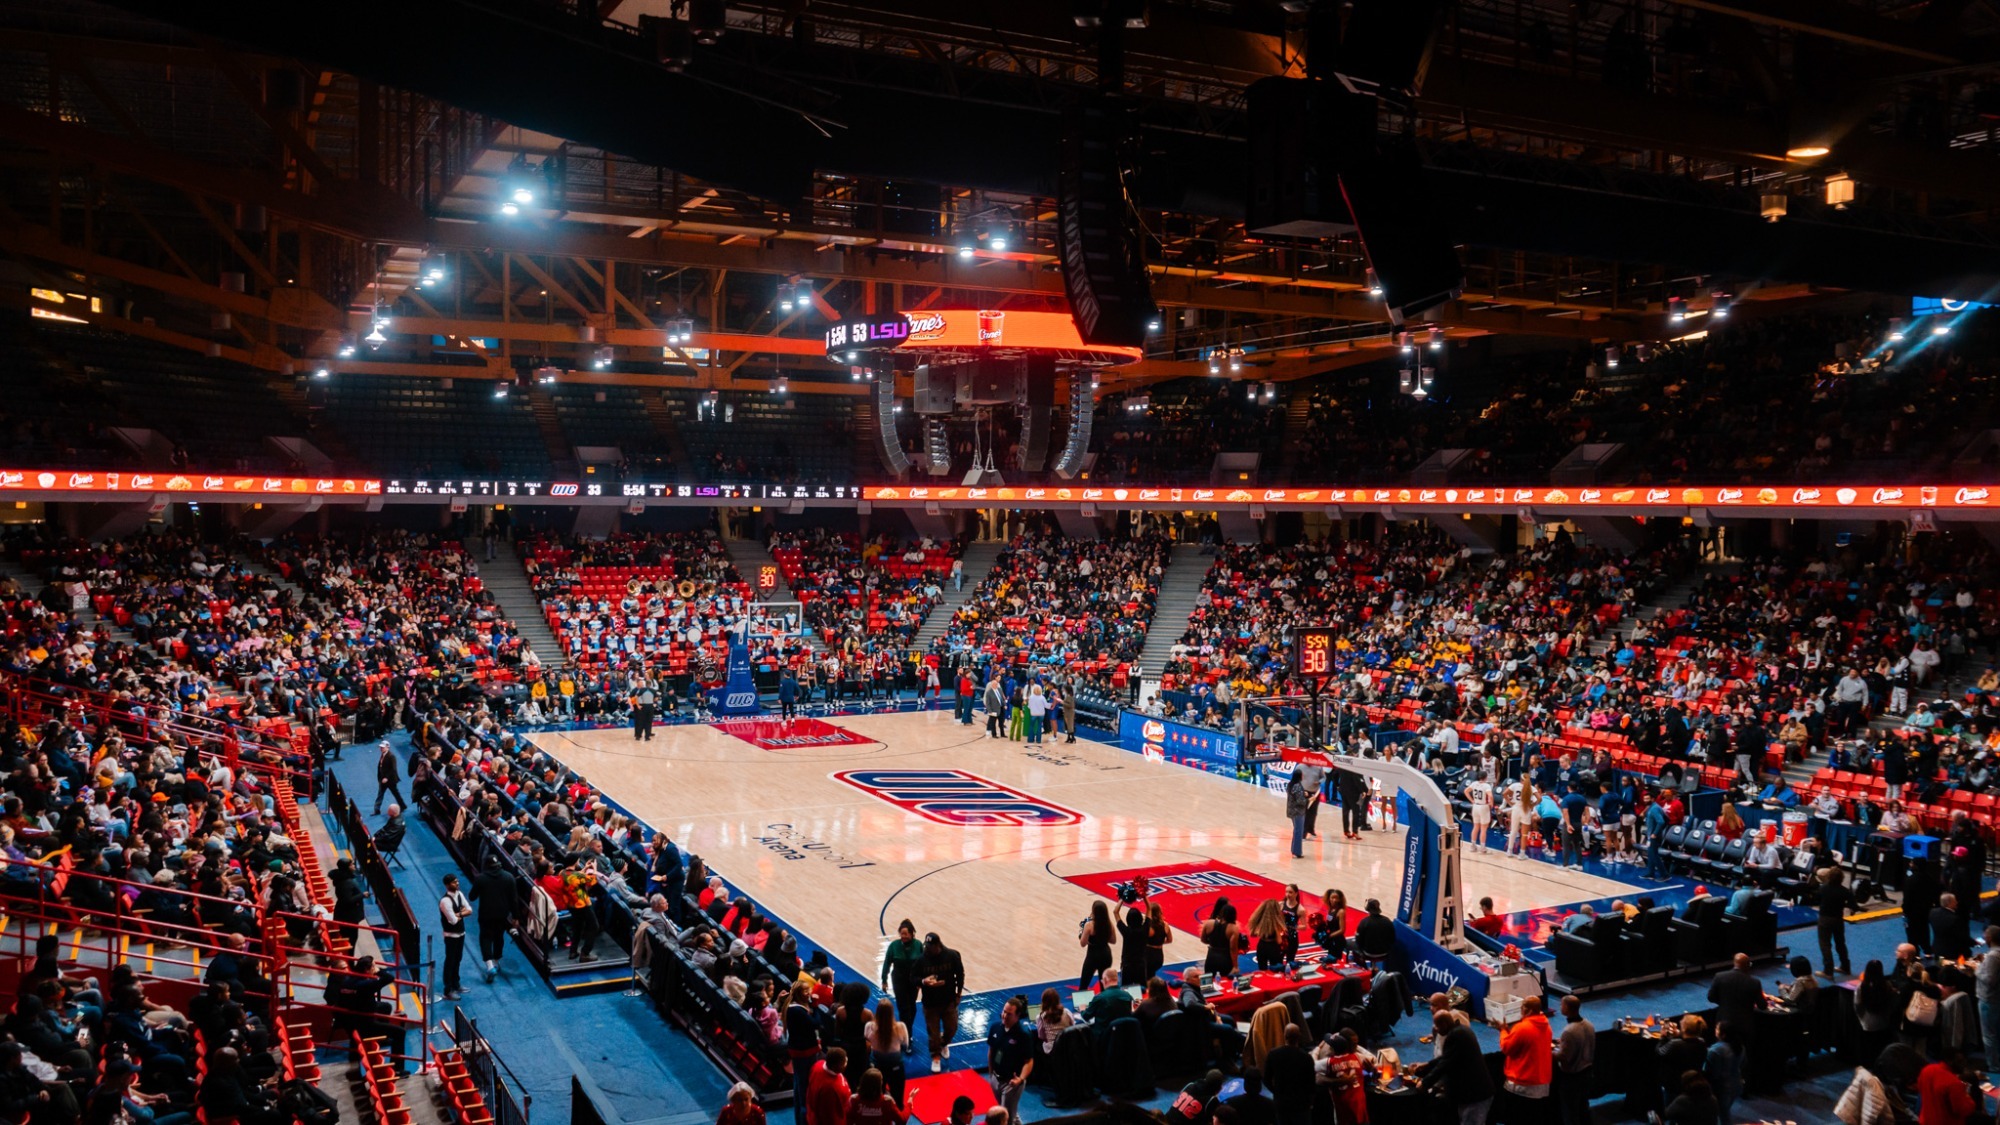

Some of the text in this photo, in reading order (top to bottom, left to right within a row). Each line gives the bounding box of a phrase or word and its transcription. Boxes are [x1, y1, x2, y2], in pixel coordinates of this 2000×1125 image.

[852, 322, 867, 342] 53
[871, 322, 907, 339] LSU
[509, 487, 516, 495] 3
[552, 485, 577, 495] UIC
[587, 484, 601, 495] 33
[623, 484, 646, 496] 5:54
[677, 485, 691, 497] 53
[696, 487, 719, 496] LSU
[761, 566, 776, 574] 5:54
[760, 574, 774, 587] 30
[1306, 635, 1328, 648] 5:54
[1304, 649, 1327, 672] 30
[727, 694, 755, 707] UIC
[843, 771, 1073, 825] UIC
[1473, 788, 1483, 800] 20
[1403, 835, 1419, 914] TicketSmarter
[1412, 959, 1459, 987] xfinity
